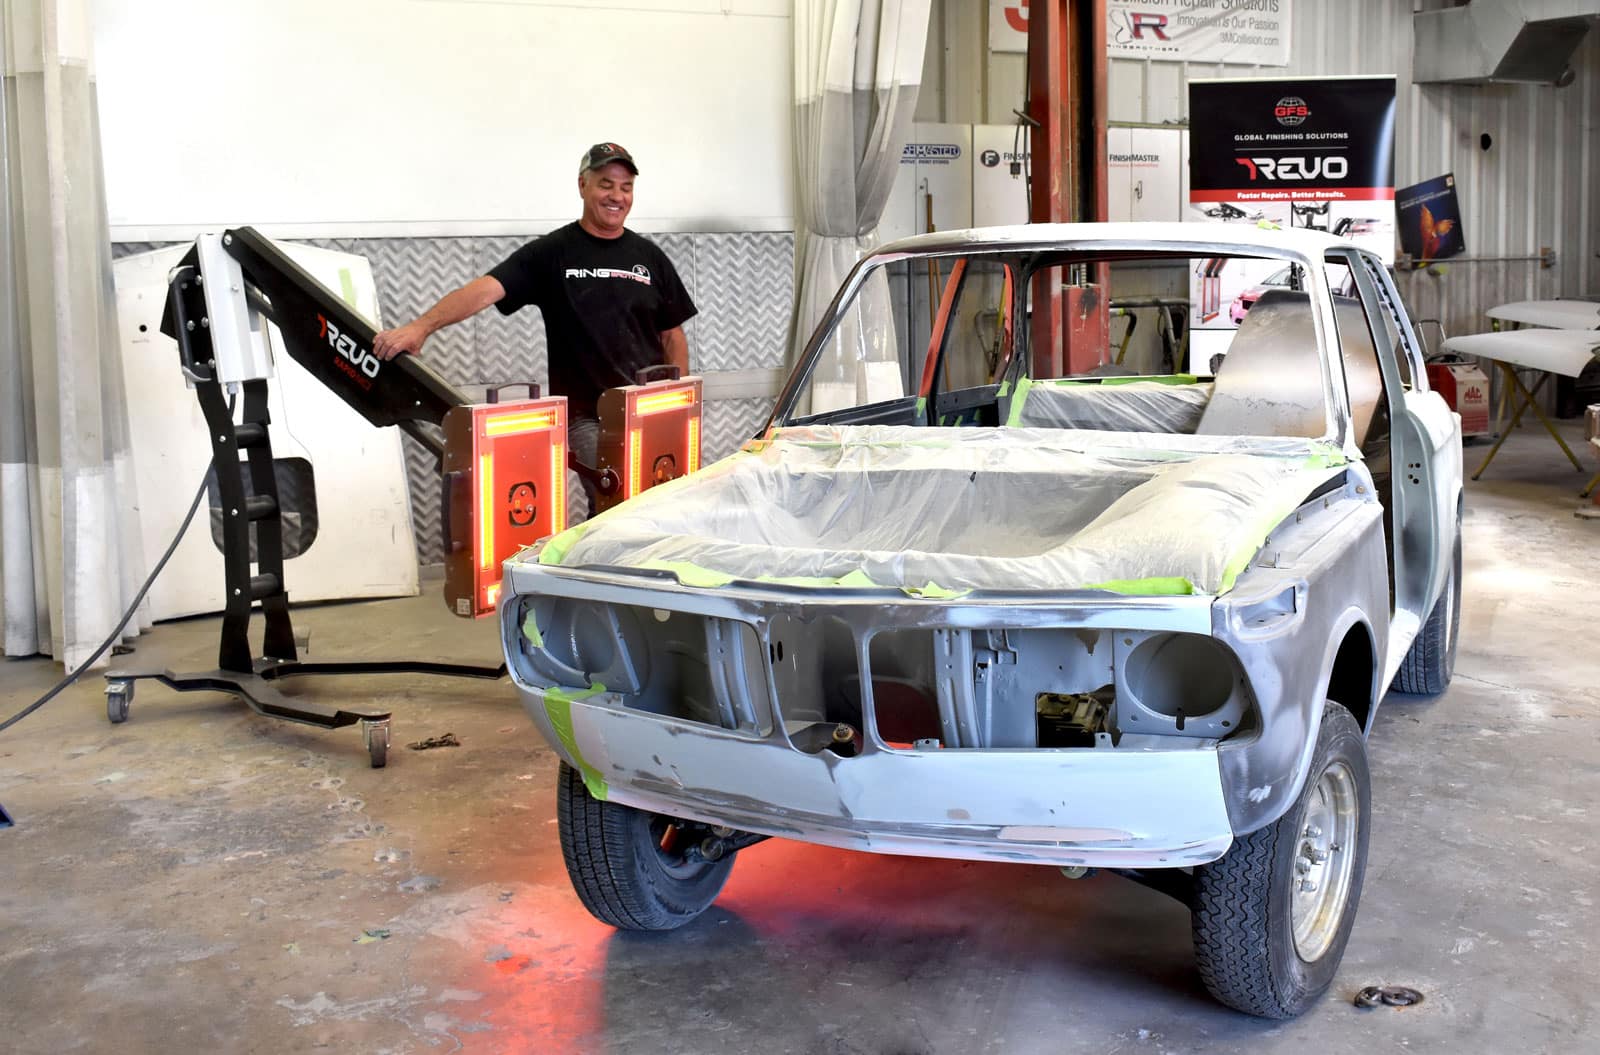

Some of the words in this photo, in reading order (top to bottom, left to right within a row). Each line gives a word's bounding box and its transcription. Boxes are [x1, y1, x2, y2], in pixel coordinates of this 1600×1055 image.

[1231, 16, 1247, 28] Our
[1248, 17, 1279, 31] Passion
[1274, 106, 1308, 116] GFS
[1109, 154, 1160, 162] FINISHMASTER
[1261, 191, 1290, 200] Repairs.
[1315, 190, 1346, 198] Results.
